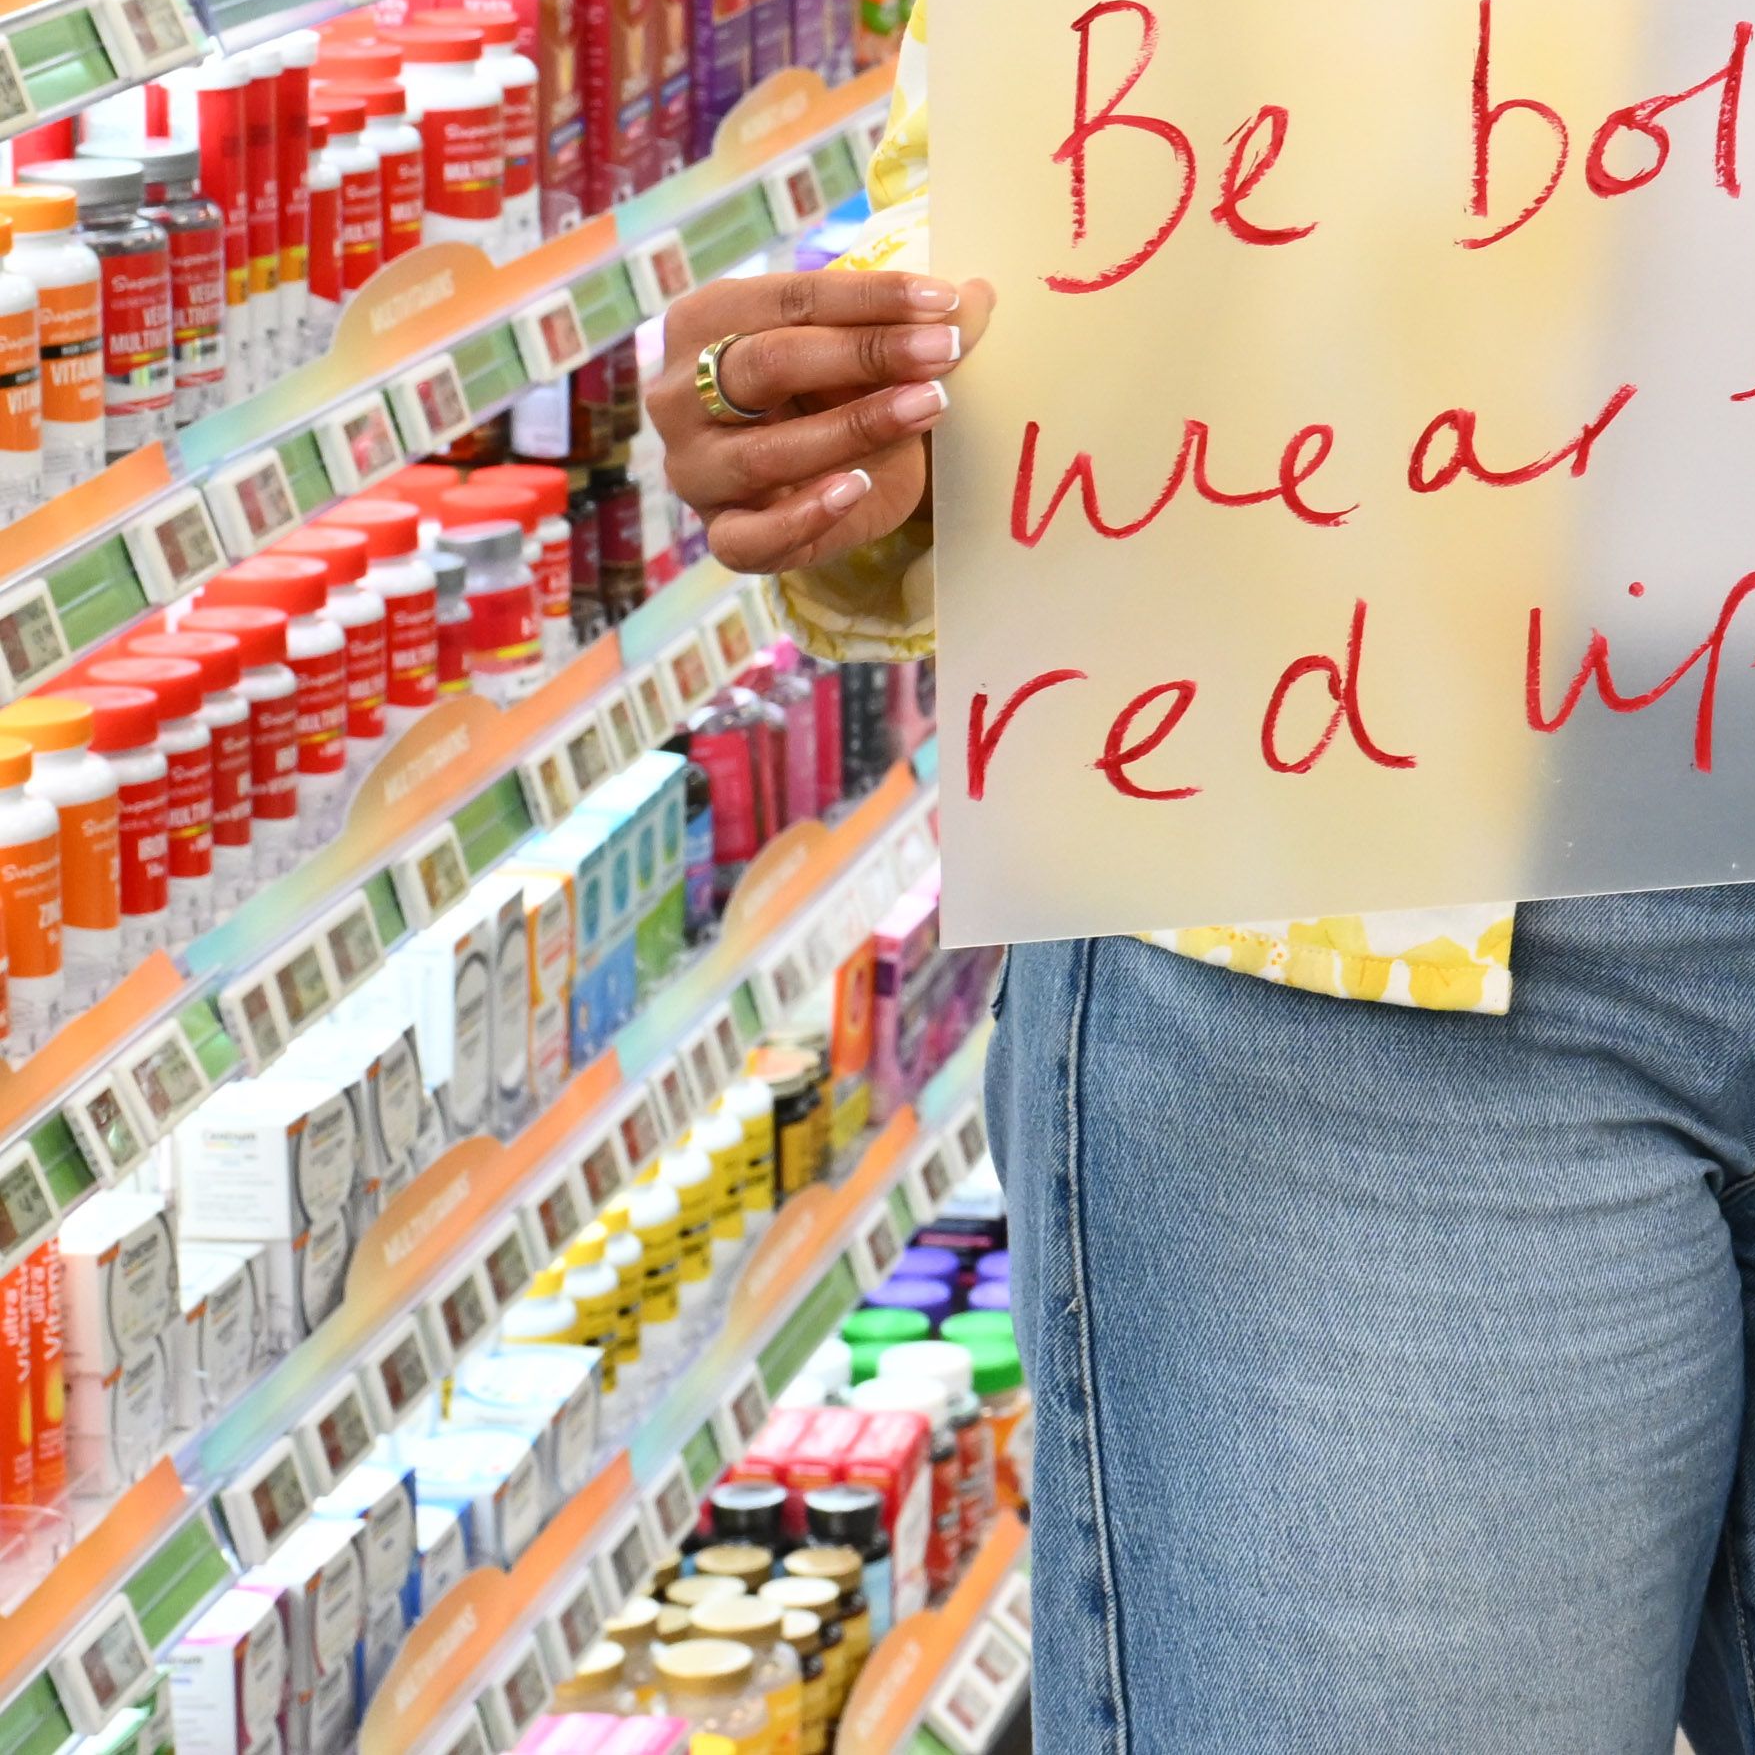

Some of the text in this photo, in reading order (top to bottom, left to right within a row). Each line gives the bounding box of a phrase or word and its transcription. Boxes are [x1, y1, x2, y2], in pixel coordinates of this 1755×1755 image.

[1044, 0, 1318, 294] Be
[1010, 384, 1638, 548] wear
[966, 597, 1418, 801] red
